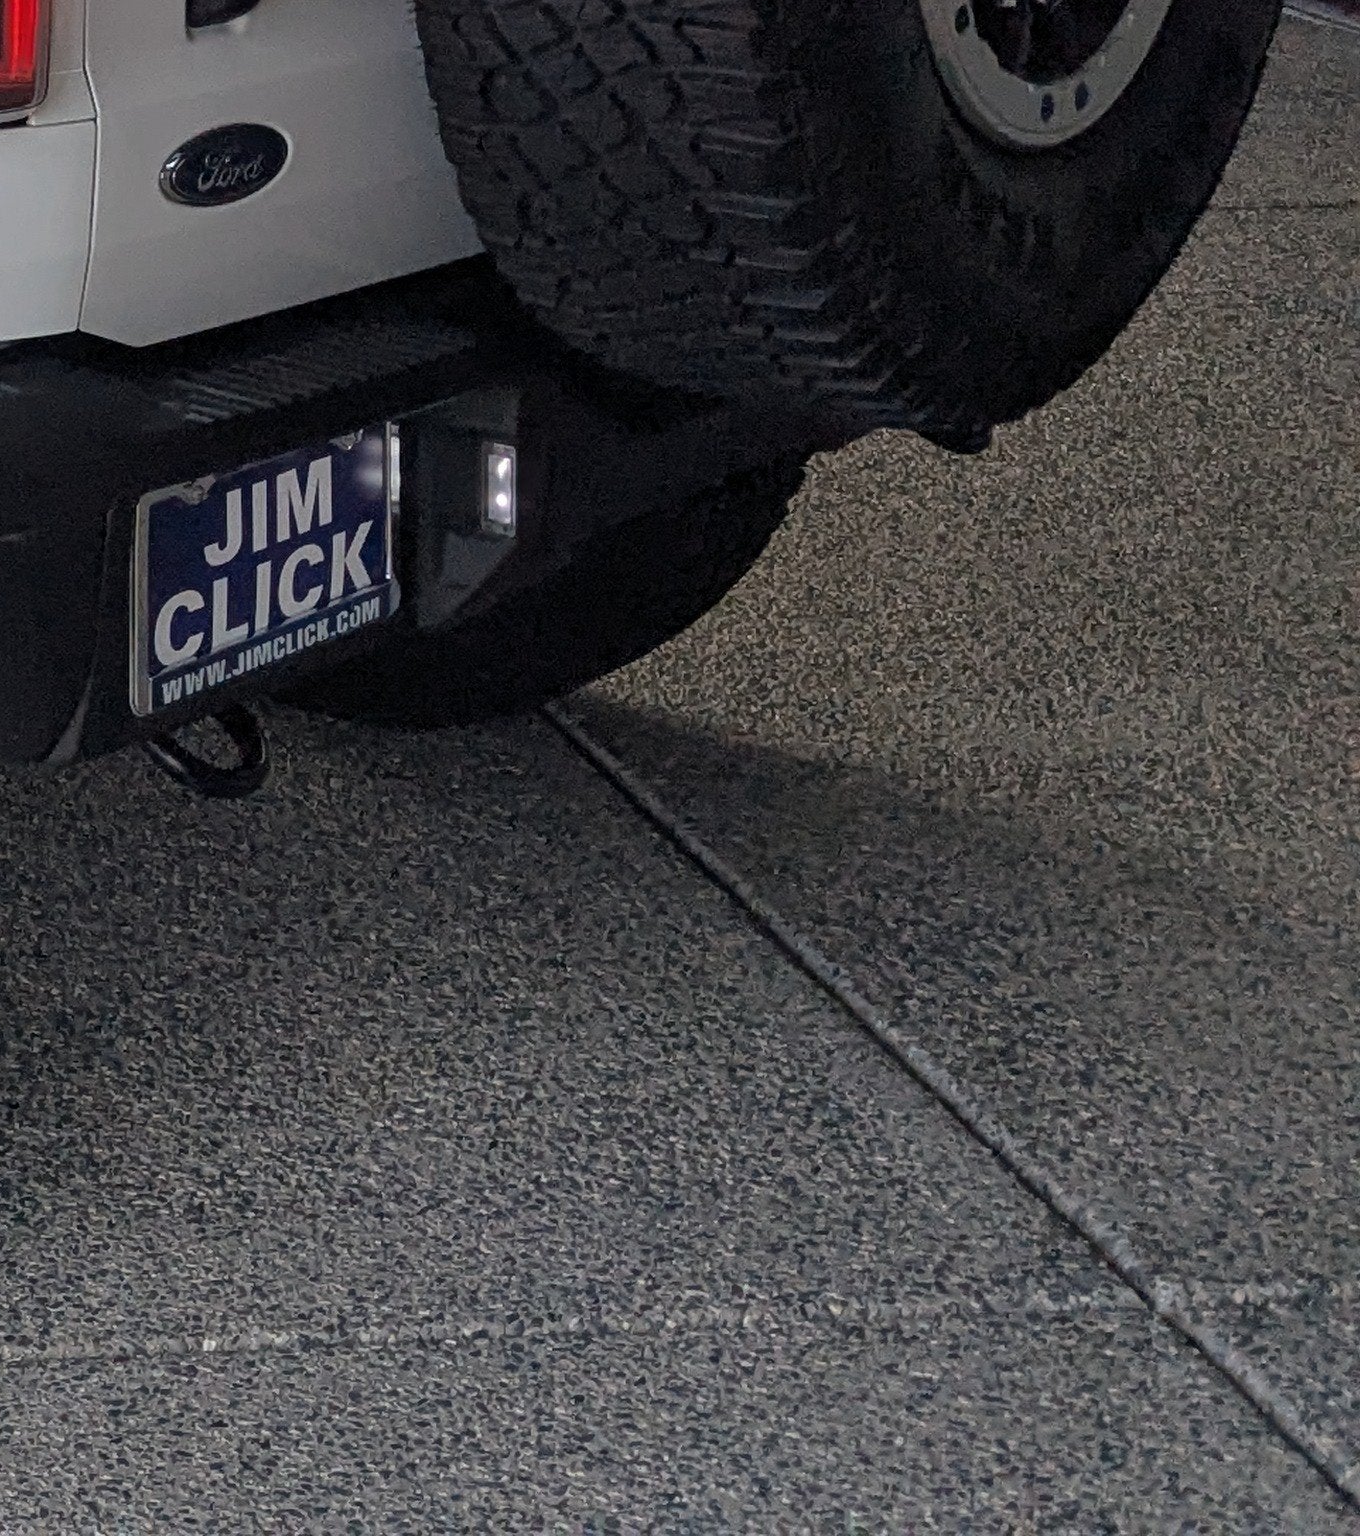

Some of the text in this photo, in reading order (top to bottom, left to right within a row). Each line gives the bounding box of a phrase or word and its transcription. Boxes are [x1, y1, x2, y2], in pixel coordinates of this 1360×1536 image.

[196, 151, 266, 193] Ford
[203, 454, 333, 568] JIM
[153, 519, 373, 668] CLICK
[161, 596, 381, 706] WWW.JIMCLICK.COM
